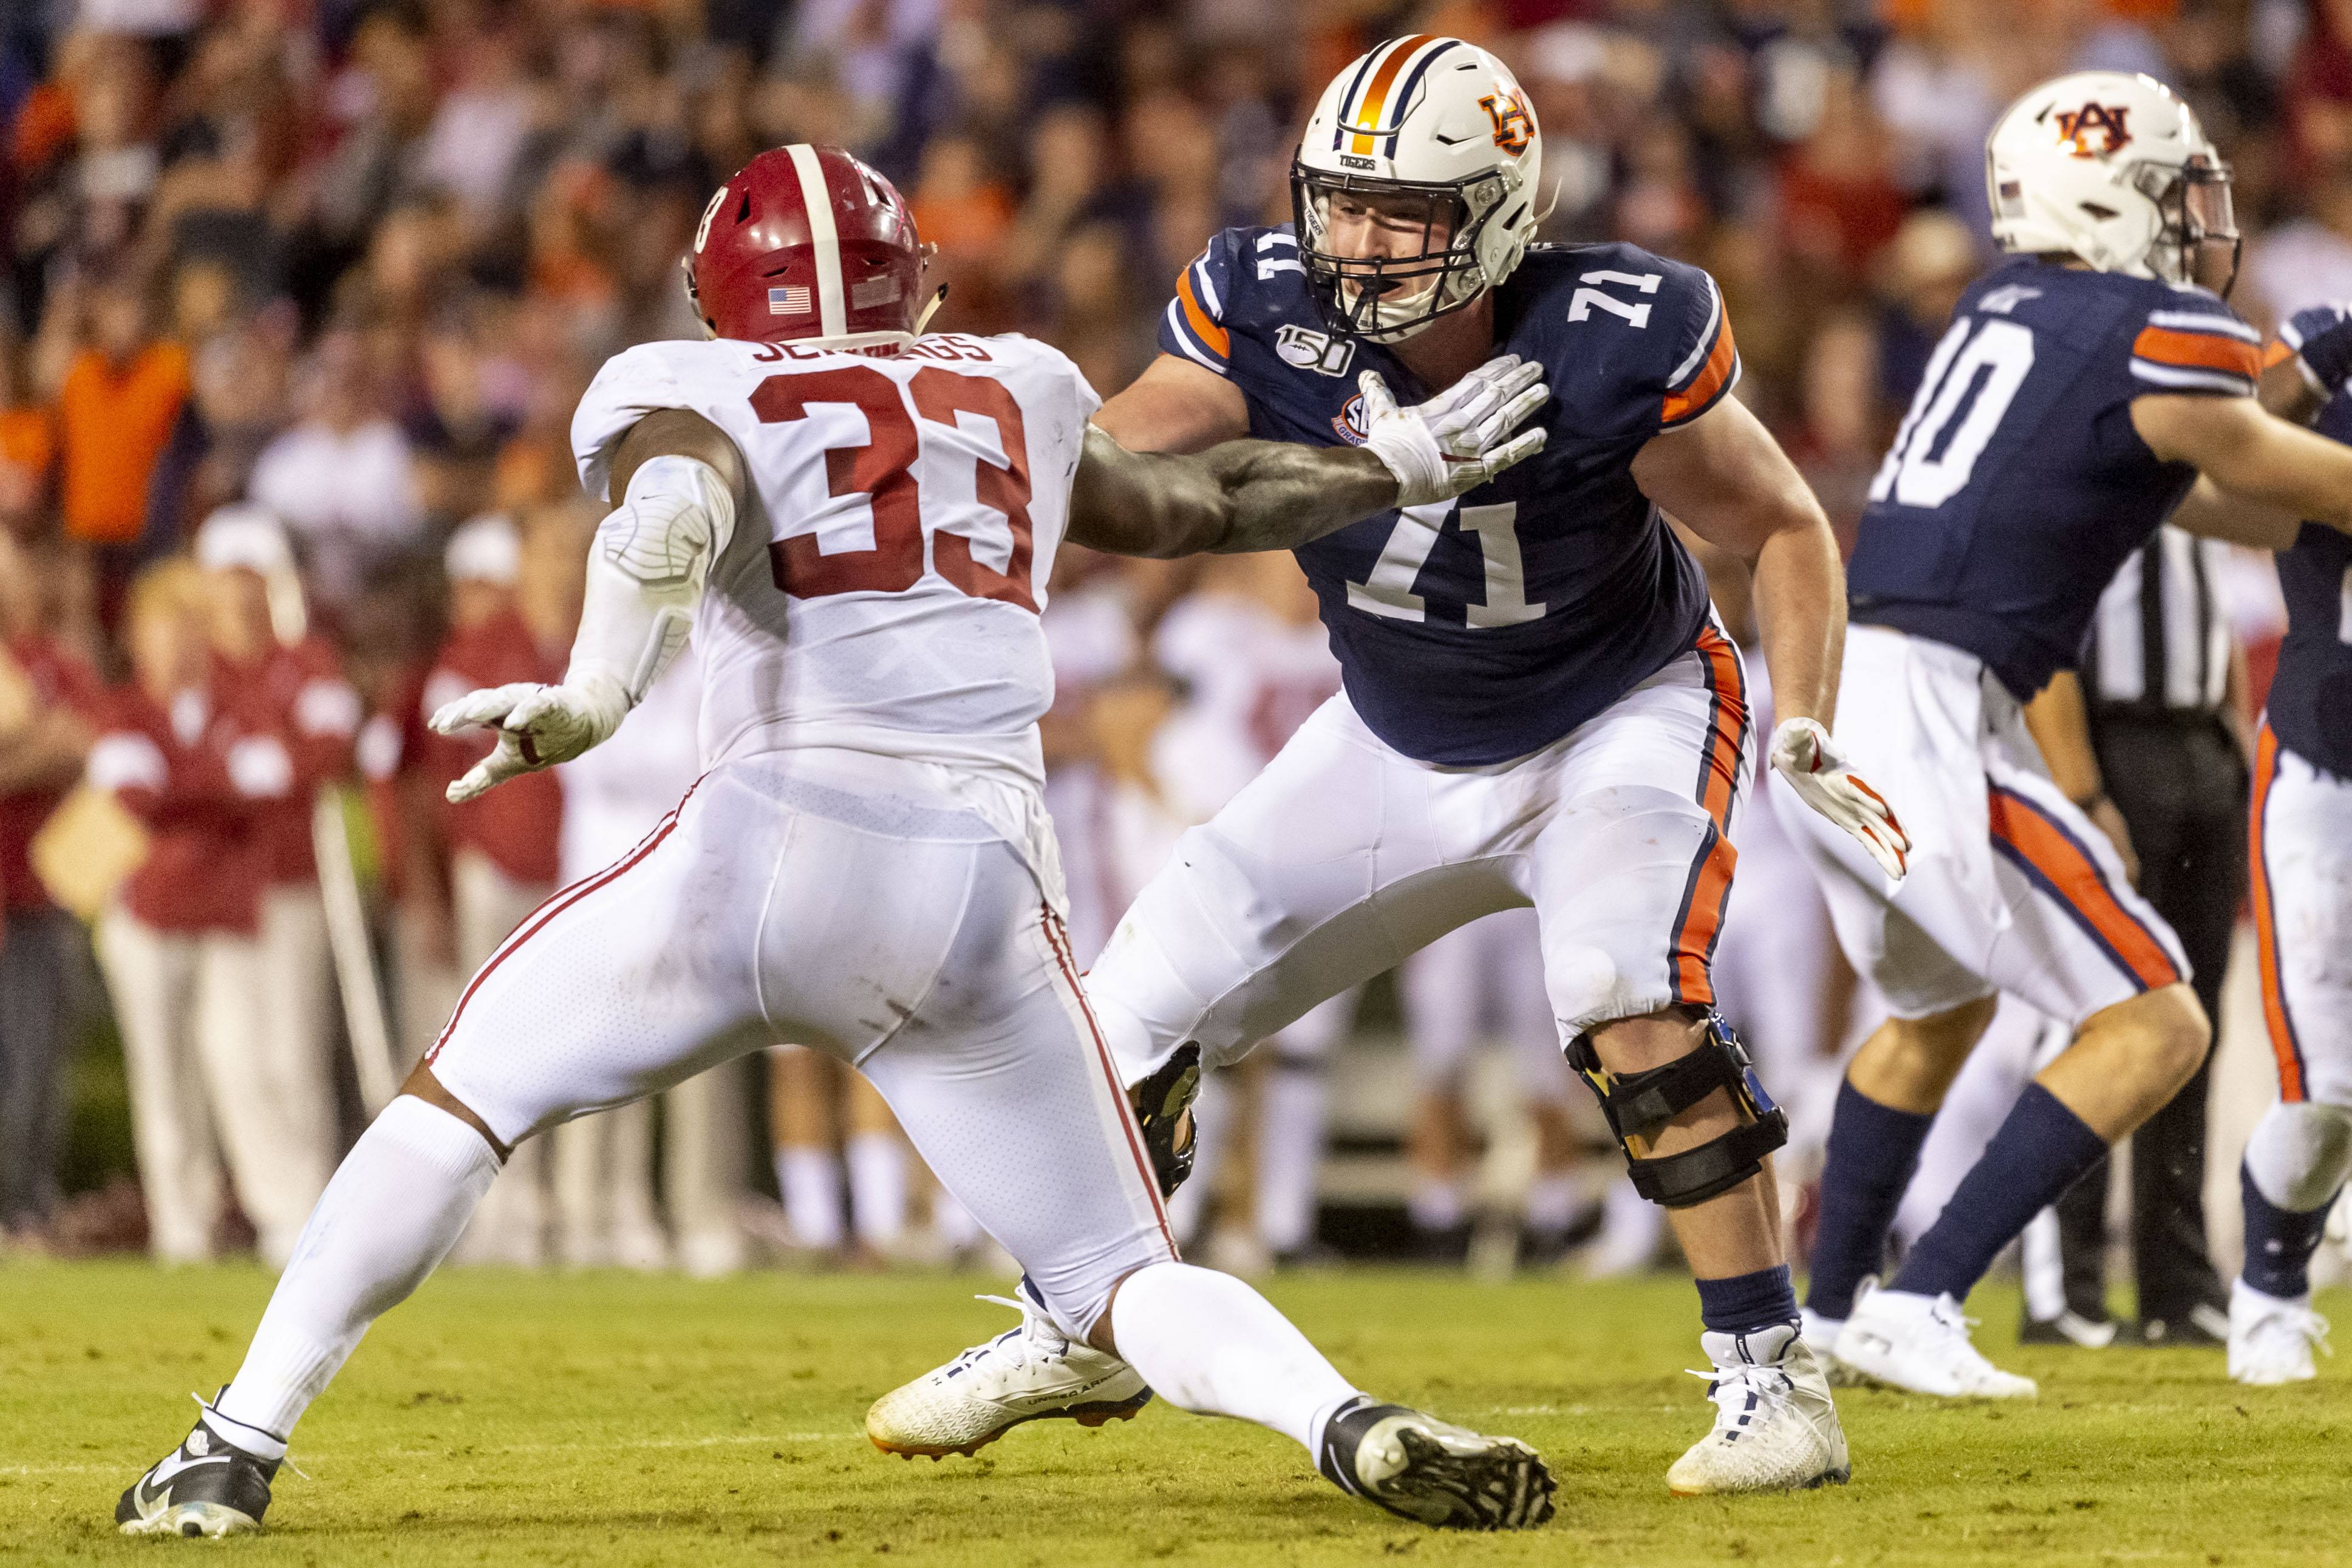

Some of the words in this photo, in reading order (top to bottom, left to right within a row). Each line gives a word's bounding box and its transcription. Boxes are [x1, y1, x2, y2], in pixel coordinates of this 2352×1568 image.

[1340, 154, 1375, 171] TIGERS
[1306, 208, 1323, 236] TIGERS
[1567, 270, 1663, 329] 71
[1275, 324, 1355, 377] 150
[749, 364, 1042, 615] 33
